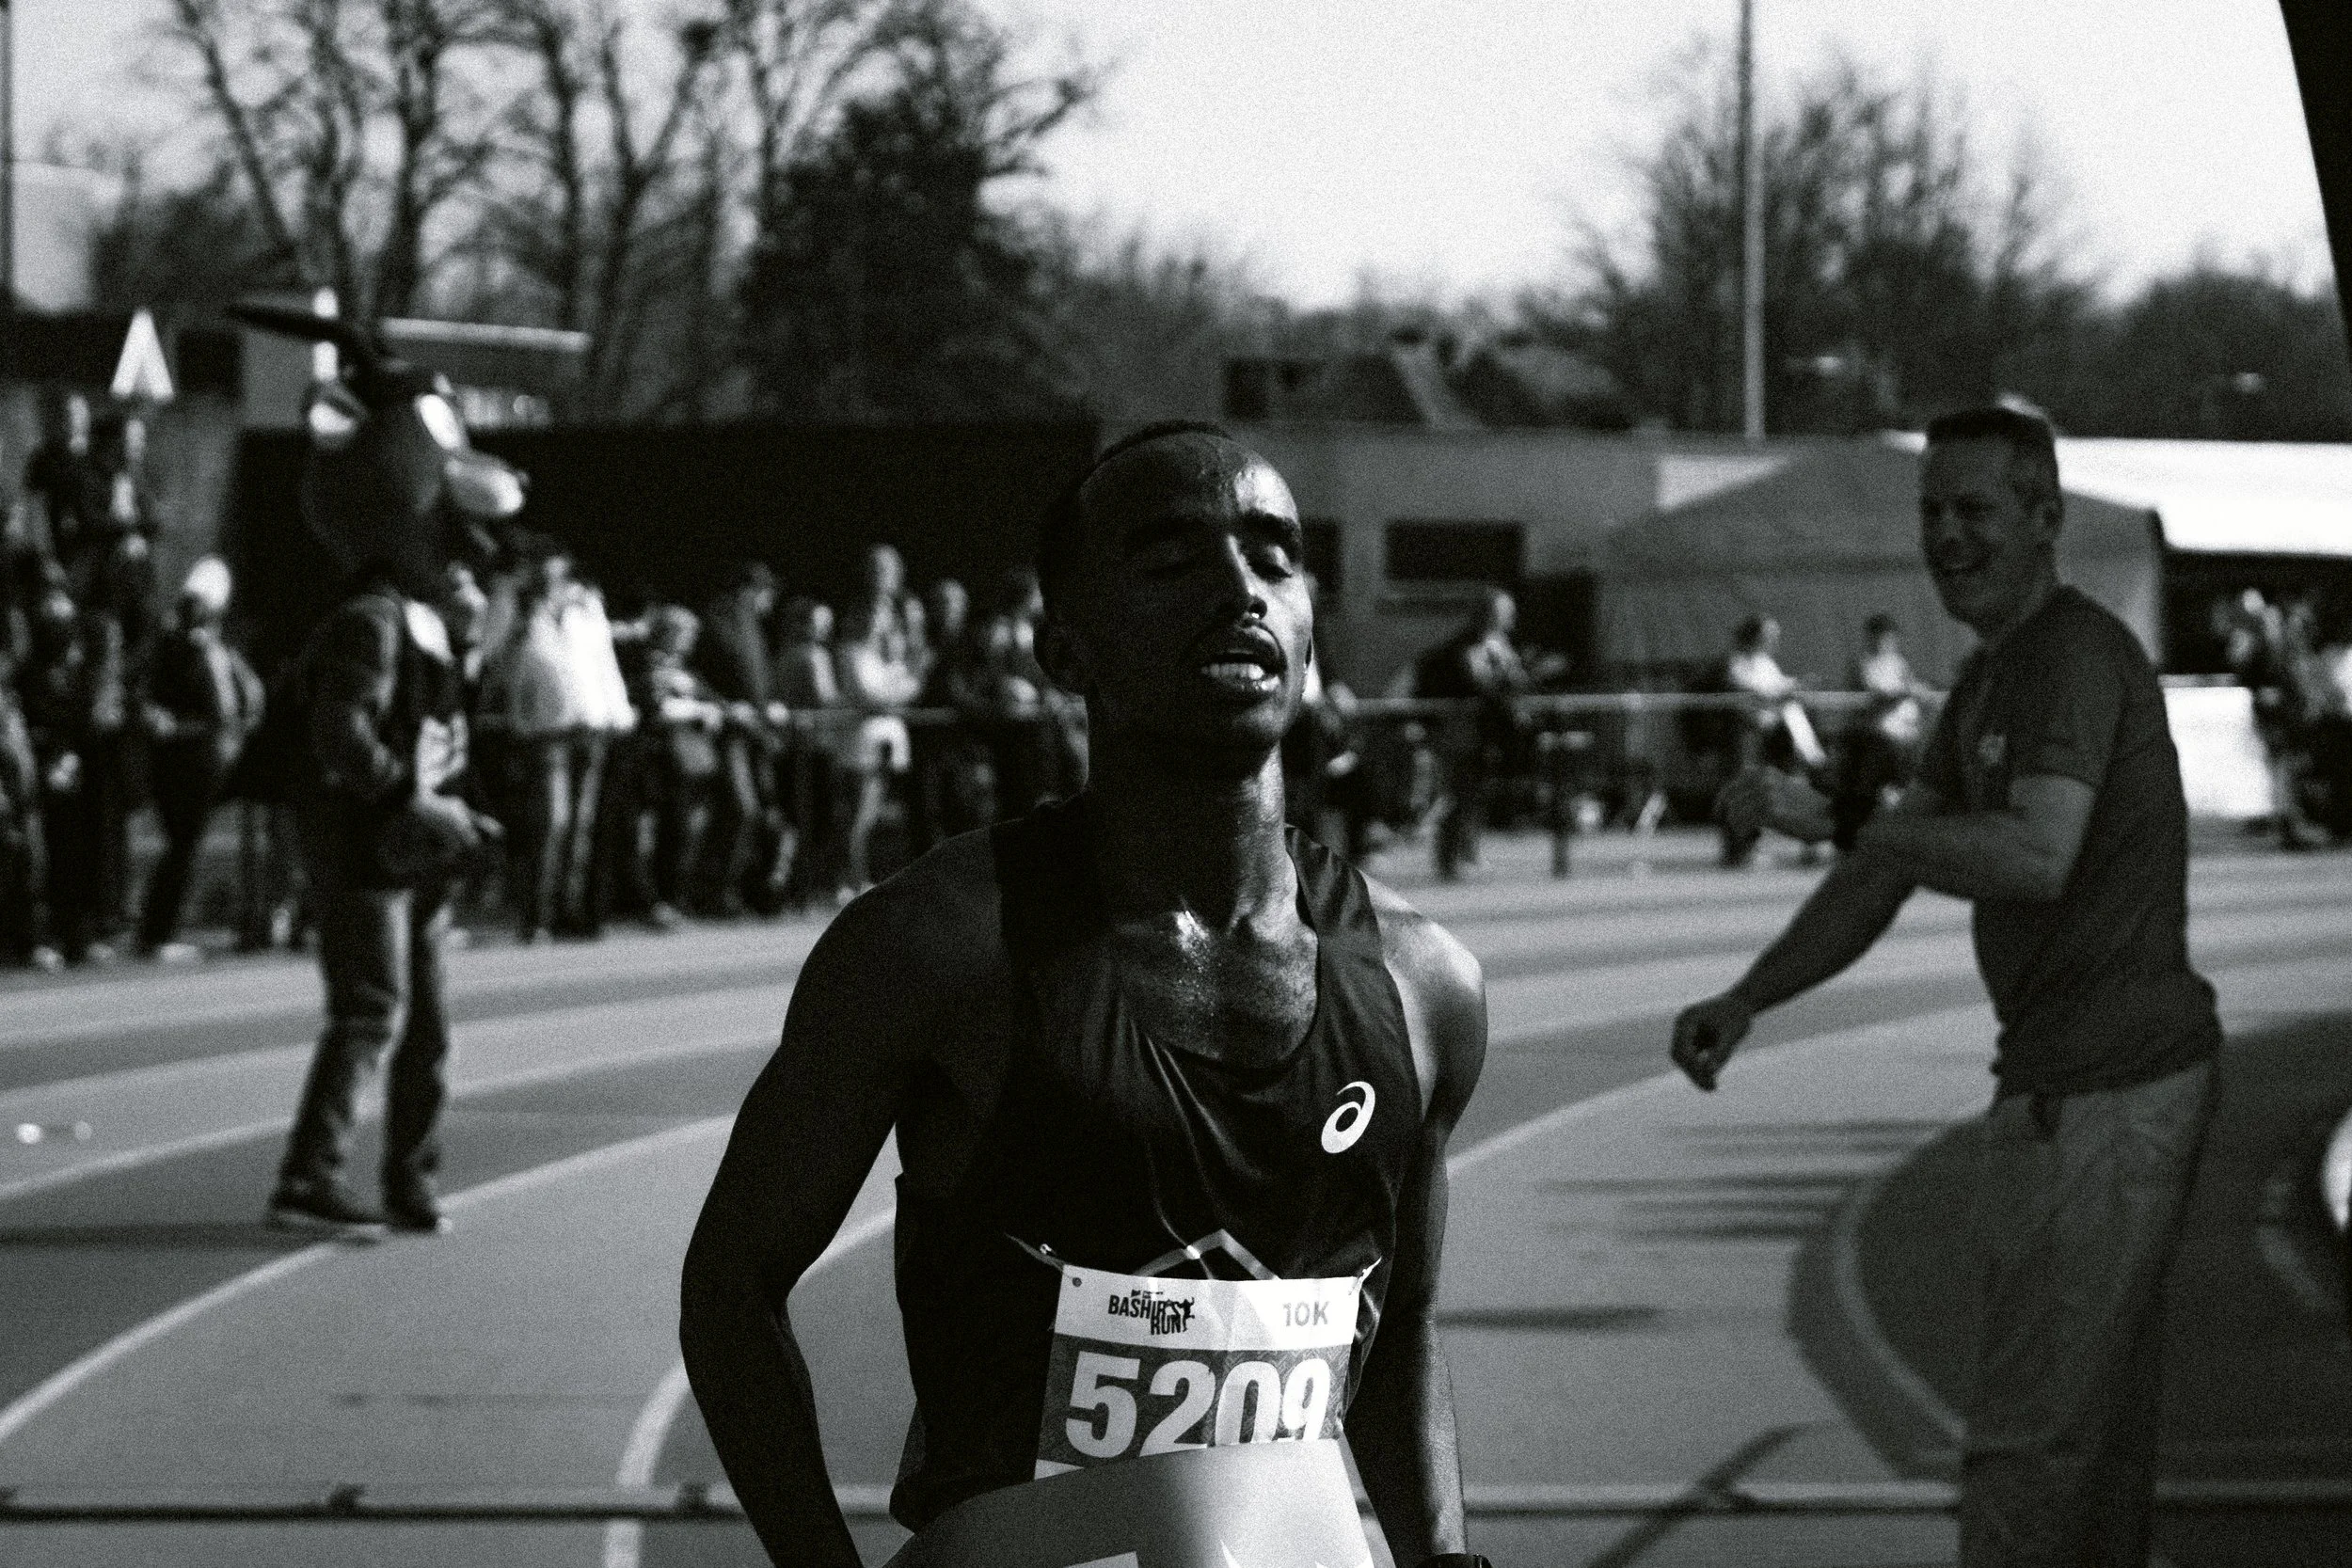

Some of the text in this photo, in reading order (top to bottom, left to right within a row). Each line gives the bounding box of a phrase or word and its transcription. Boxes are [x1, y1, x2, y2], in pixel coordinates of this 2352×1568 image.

[1150, 1314, 1182, 1336] RUN
[1282, 1300, 1329, 1327] 10K
[1065, 1351, 1331, 1459] 5209
